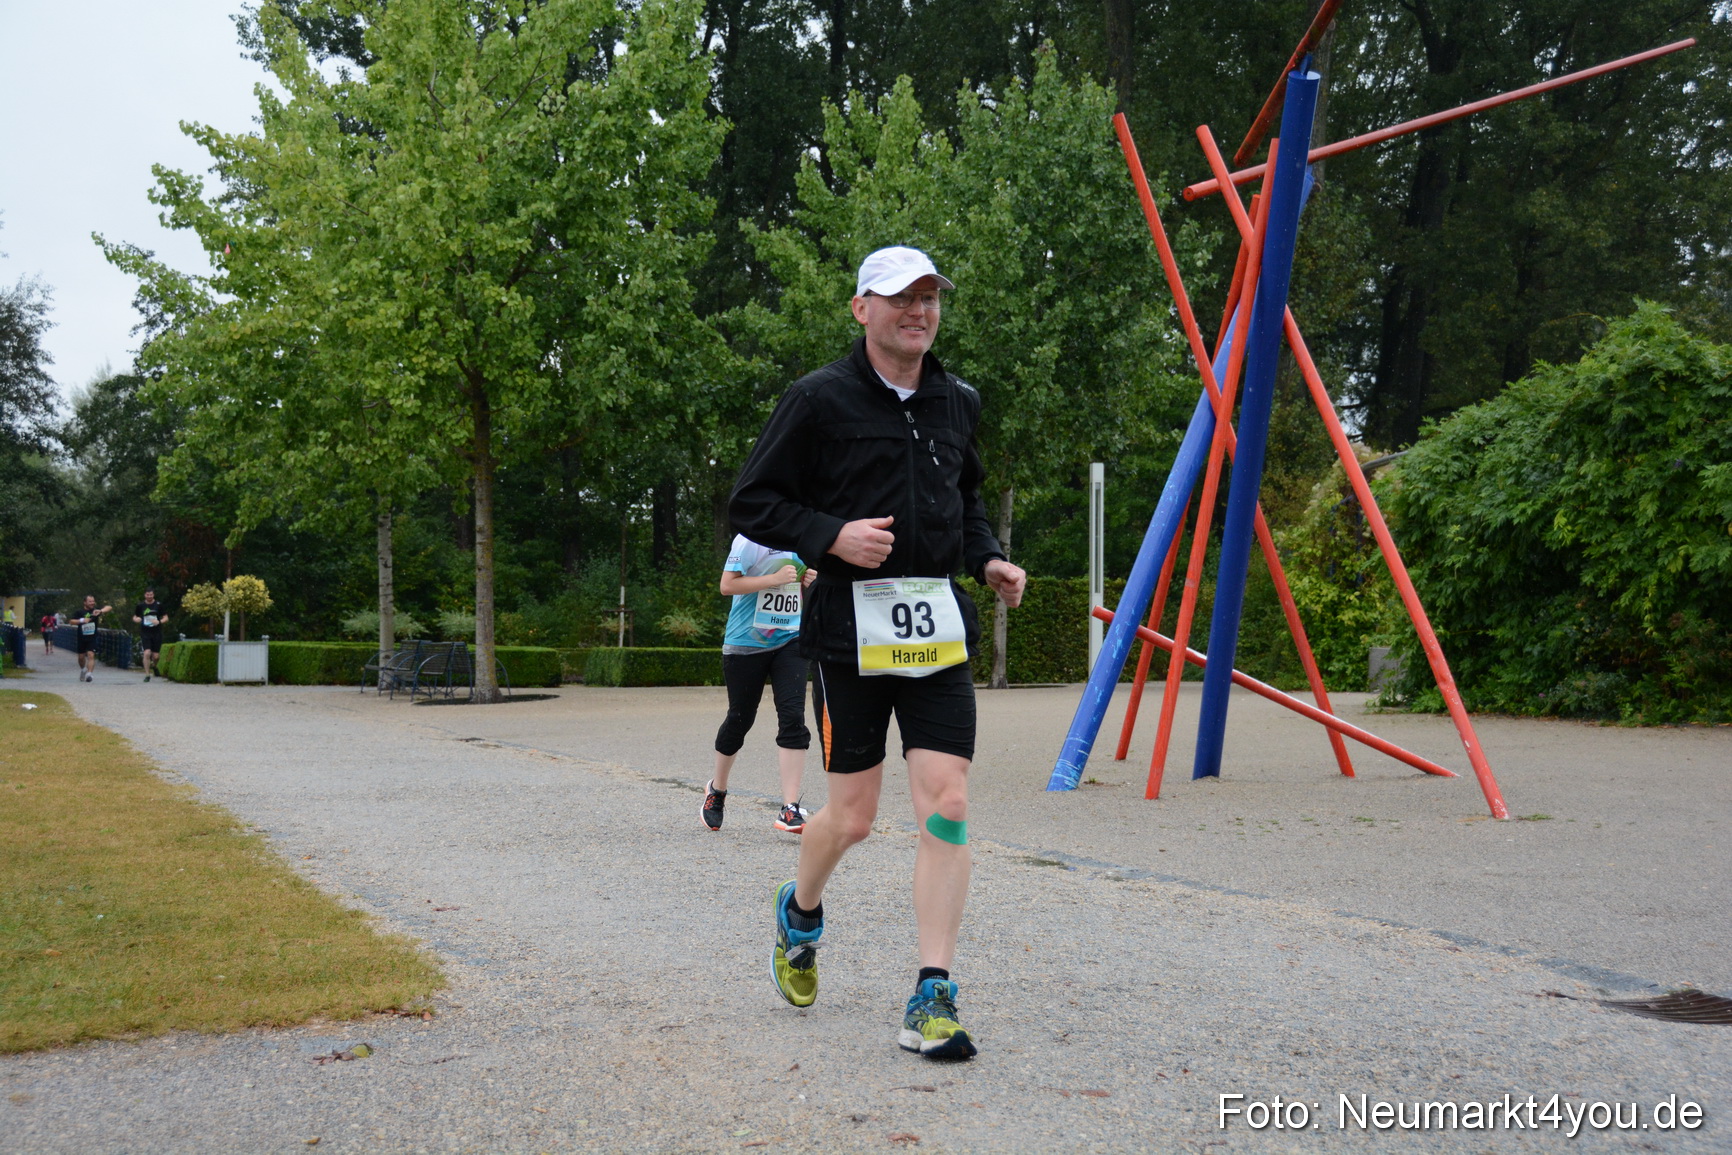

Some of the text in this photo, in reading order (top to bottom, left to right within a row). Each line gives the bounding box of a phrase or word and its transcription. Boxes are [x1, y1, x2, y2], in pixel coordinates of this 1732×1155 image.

[762, 593, 798, 612] 2066
[891, 601, 935, 639] 93
[892, 648, 937, 664] Harald
